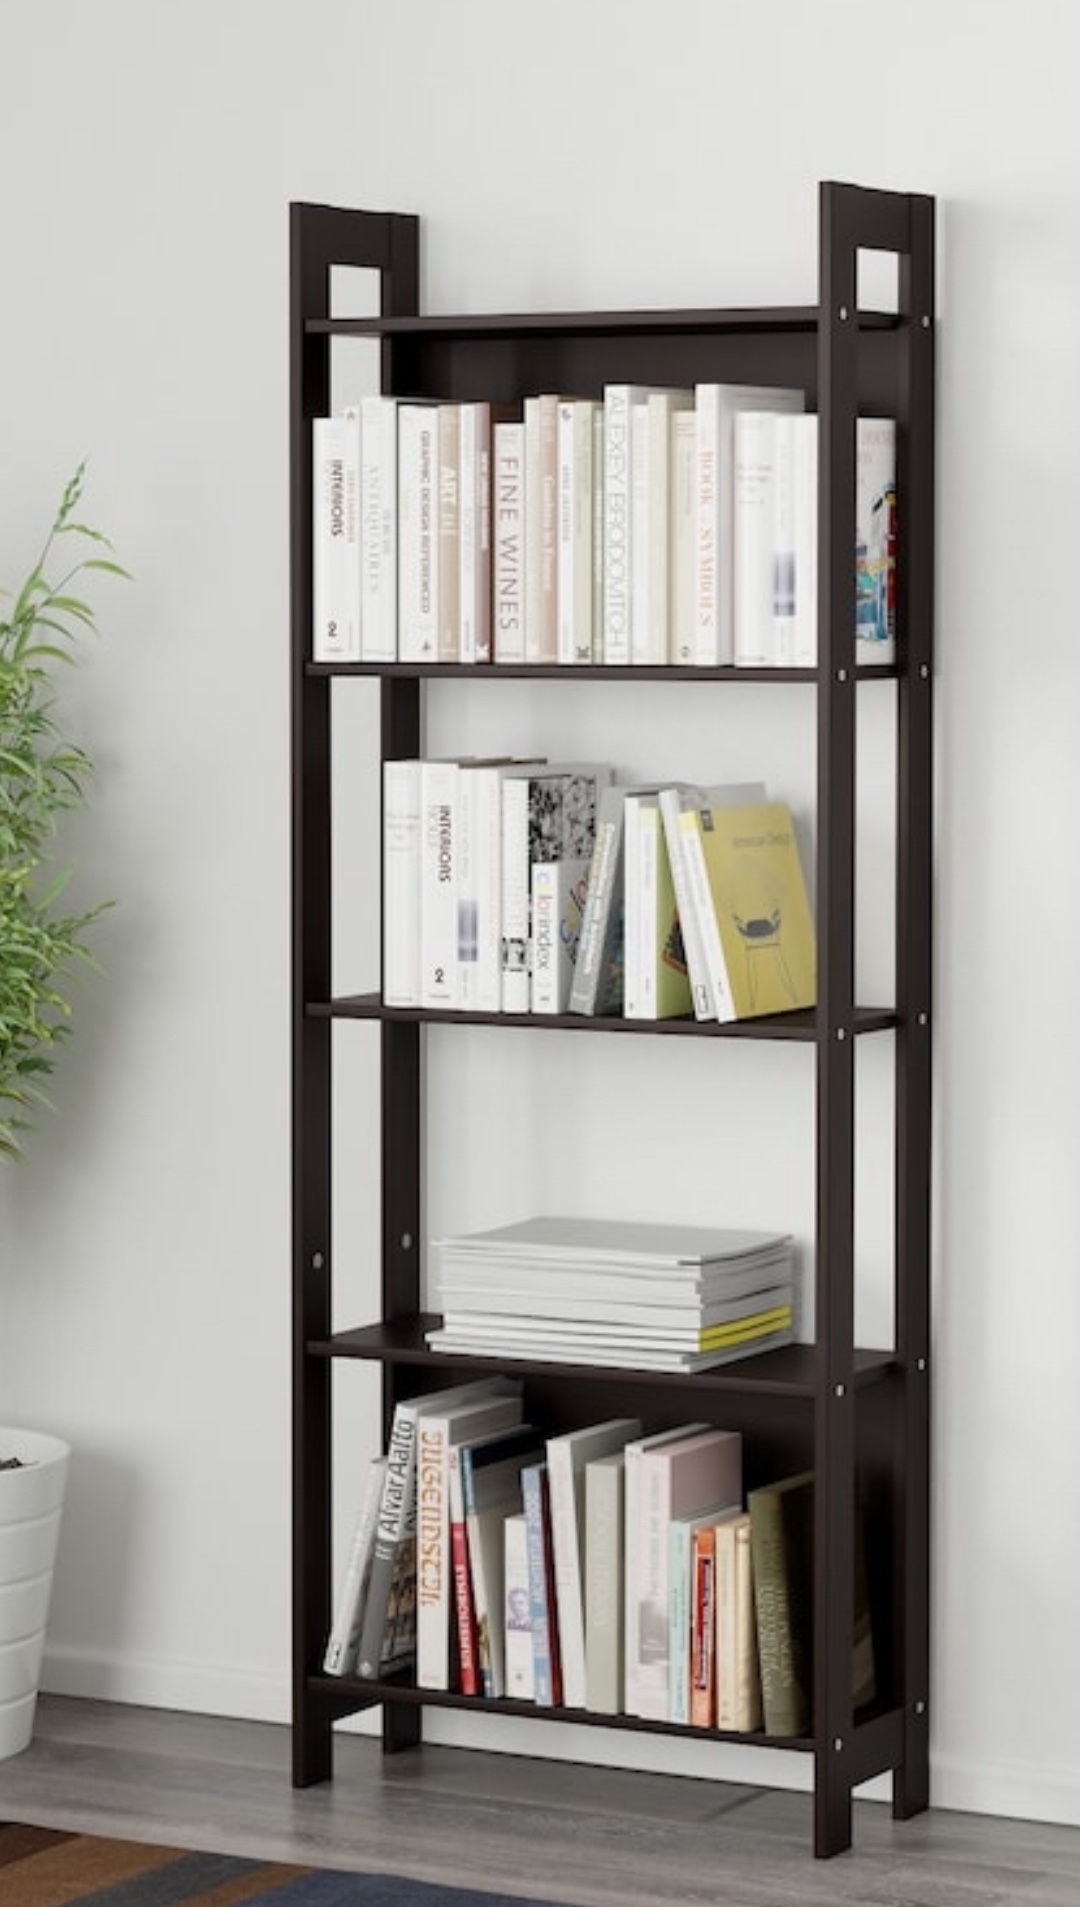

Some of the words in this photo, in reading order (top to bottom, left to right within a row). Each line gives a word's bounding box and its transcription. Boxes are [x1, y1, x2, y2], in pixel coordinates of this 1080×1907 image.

[420, 430, 431, 484] GRAPHIC
[608, 394, 626, 484] ALEXEY
[330, 459, 344, 536] INTERIORS
[420, 488, 431, 530] DESIGN
[500, 457, 520, 521] FINE
[420, 533, 431, 613] REFERENCED
[499, 534, 520, 630] WINES
[608, 492, 626, 647] BRODOVITCH
[699, 527, 714, 627] SYMBOLS
[328, 619, 338, 637] 2
[438, 804, 452, 882] INTERIORS
[536, 871, 553, 970] colorindex
[434, 968, 444, 983] 2
[388, 1420, 414, 1479] Aalto
[380, 1477, 404, 1536] Alvar
